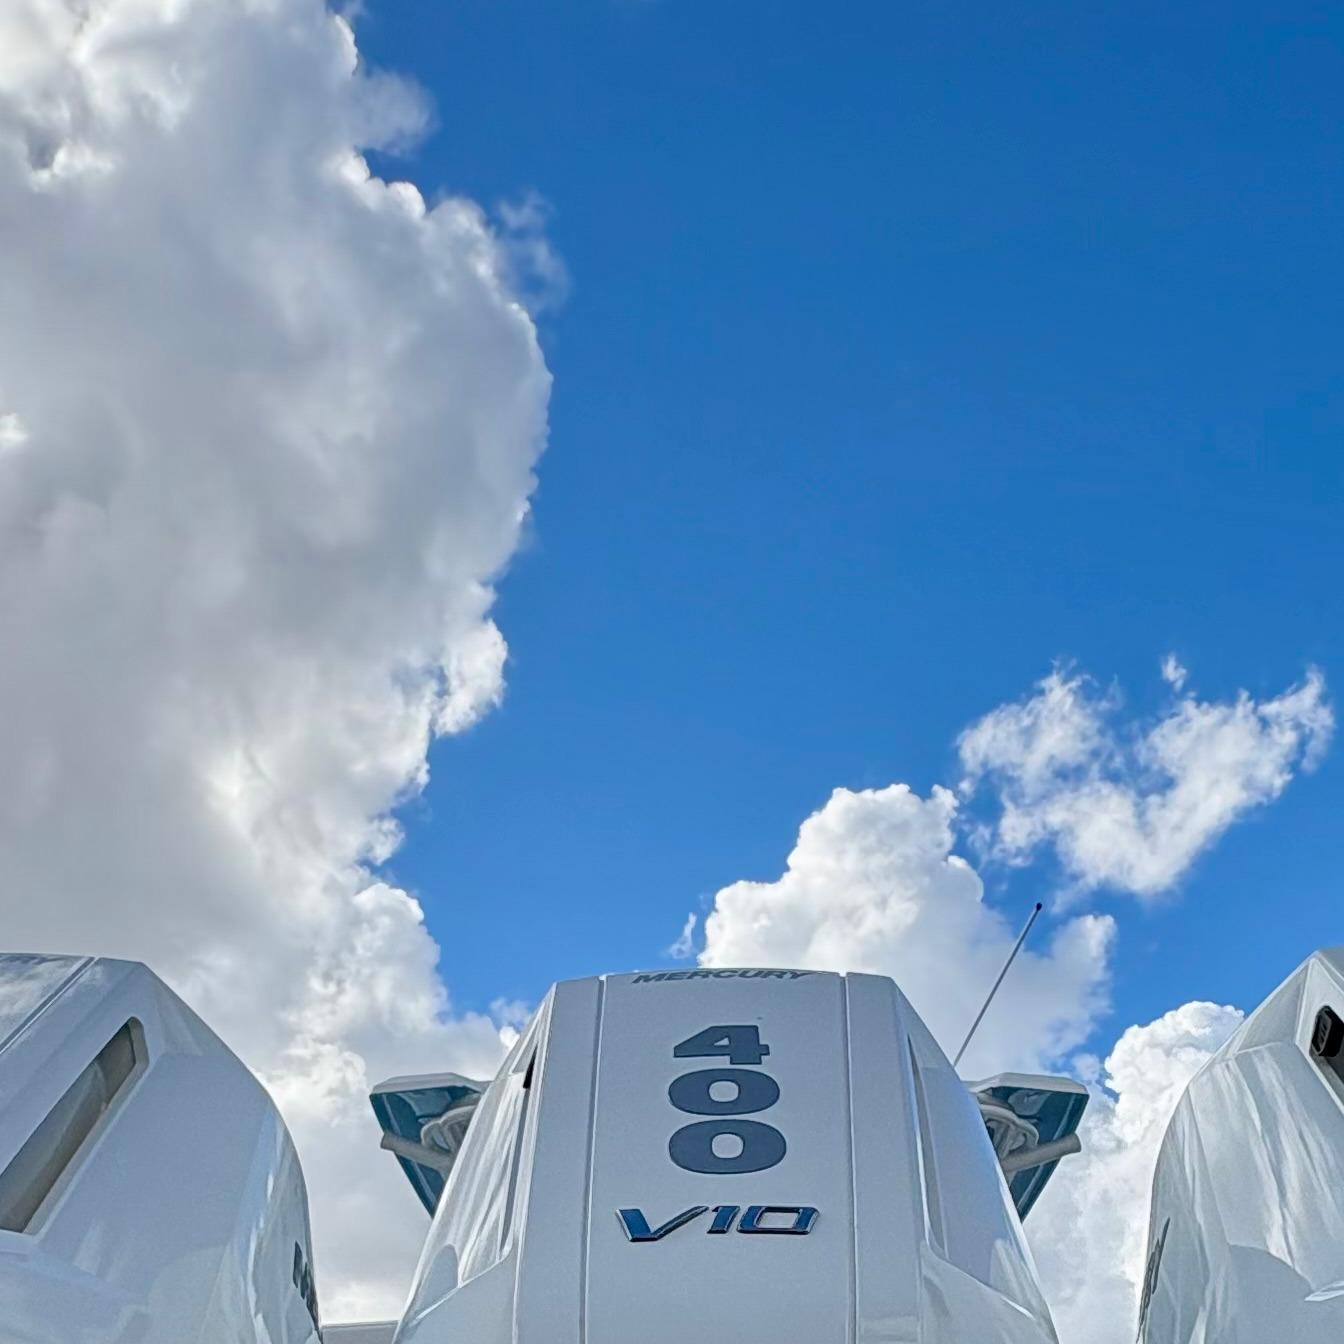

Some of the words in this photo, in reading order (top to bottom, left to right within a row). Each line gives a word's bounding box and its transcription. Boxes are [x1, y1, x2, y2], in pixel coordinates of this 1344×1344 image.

[632, 969, 816, 985] MERCURY
[667, 1023, 788, 1175] 400
[615, 1204, 822, 1243] V10
